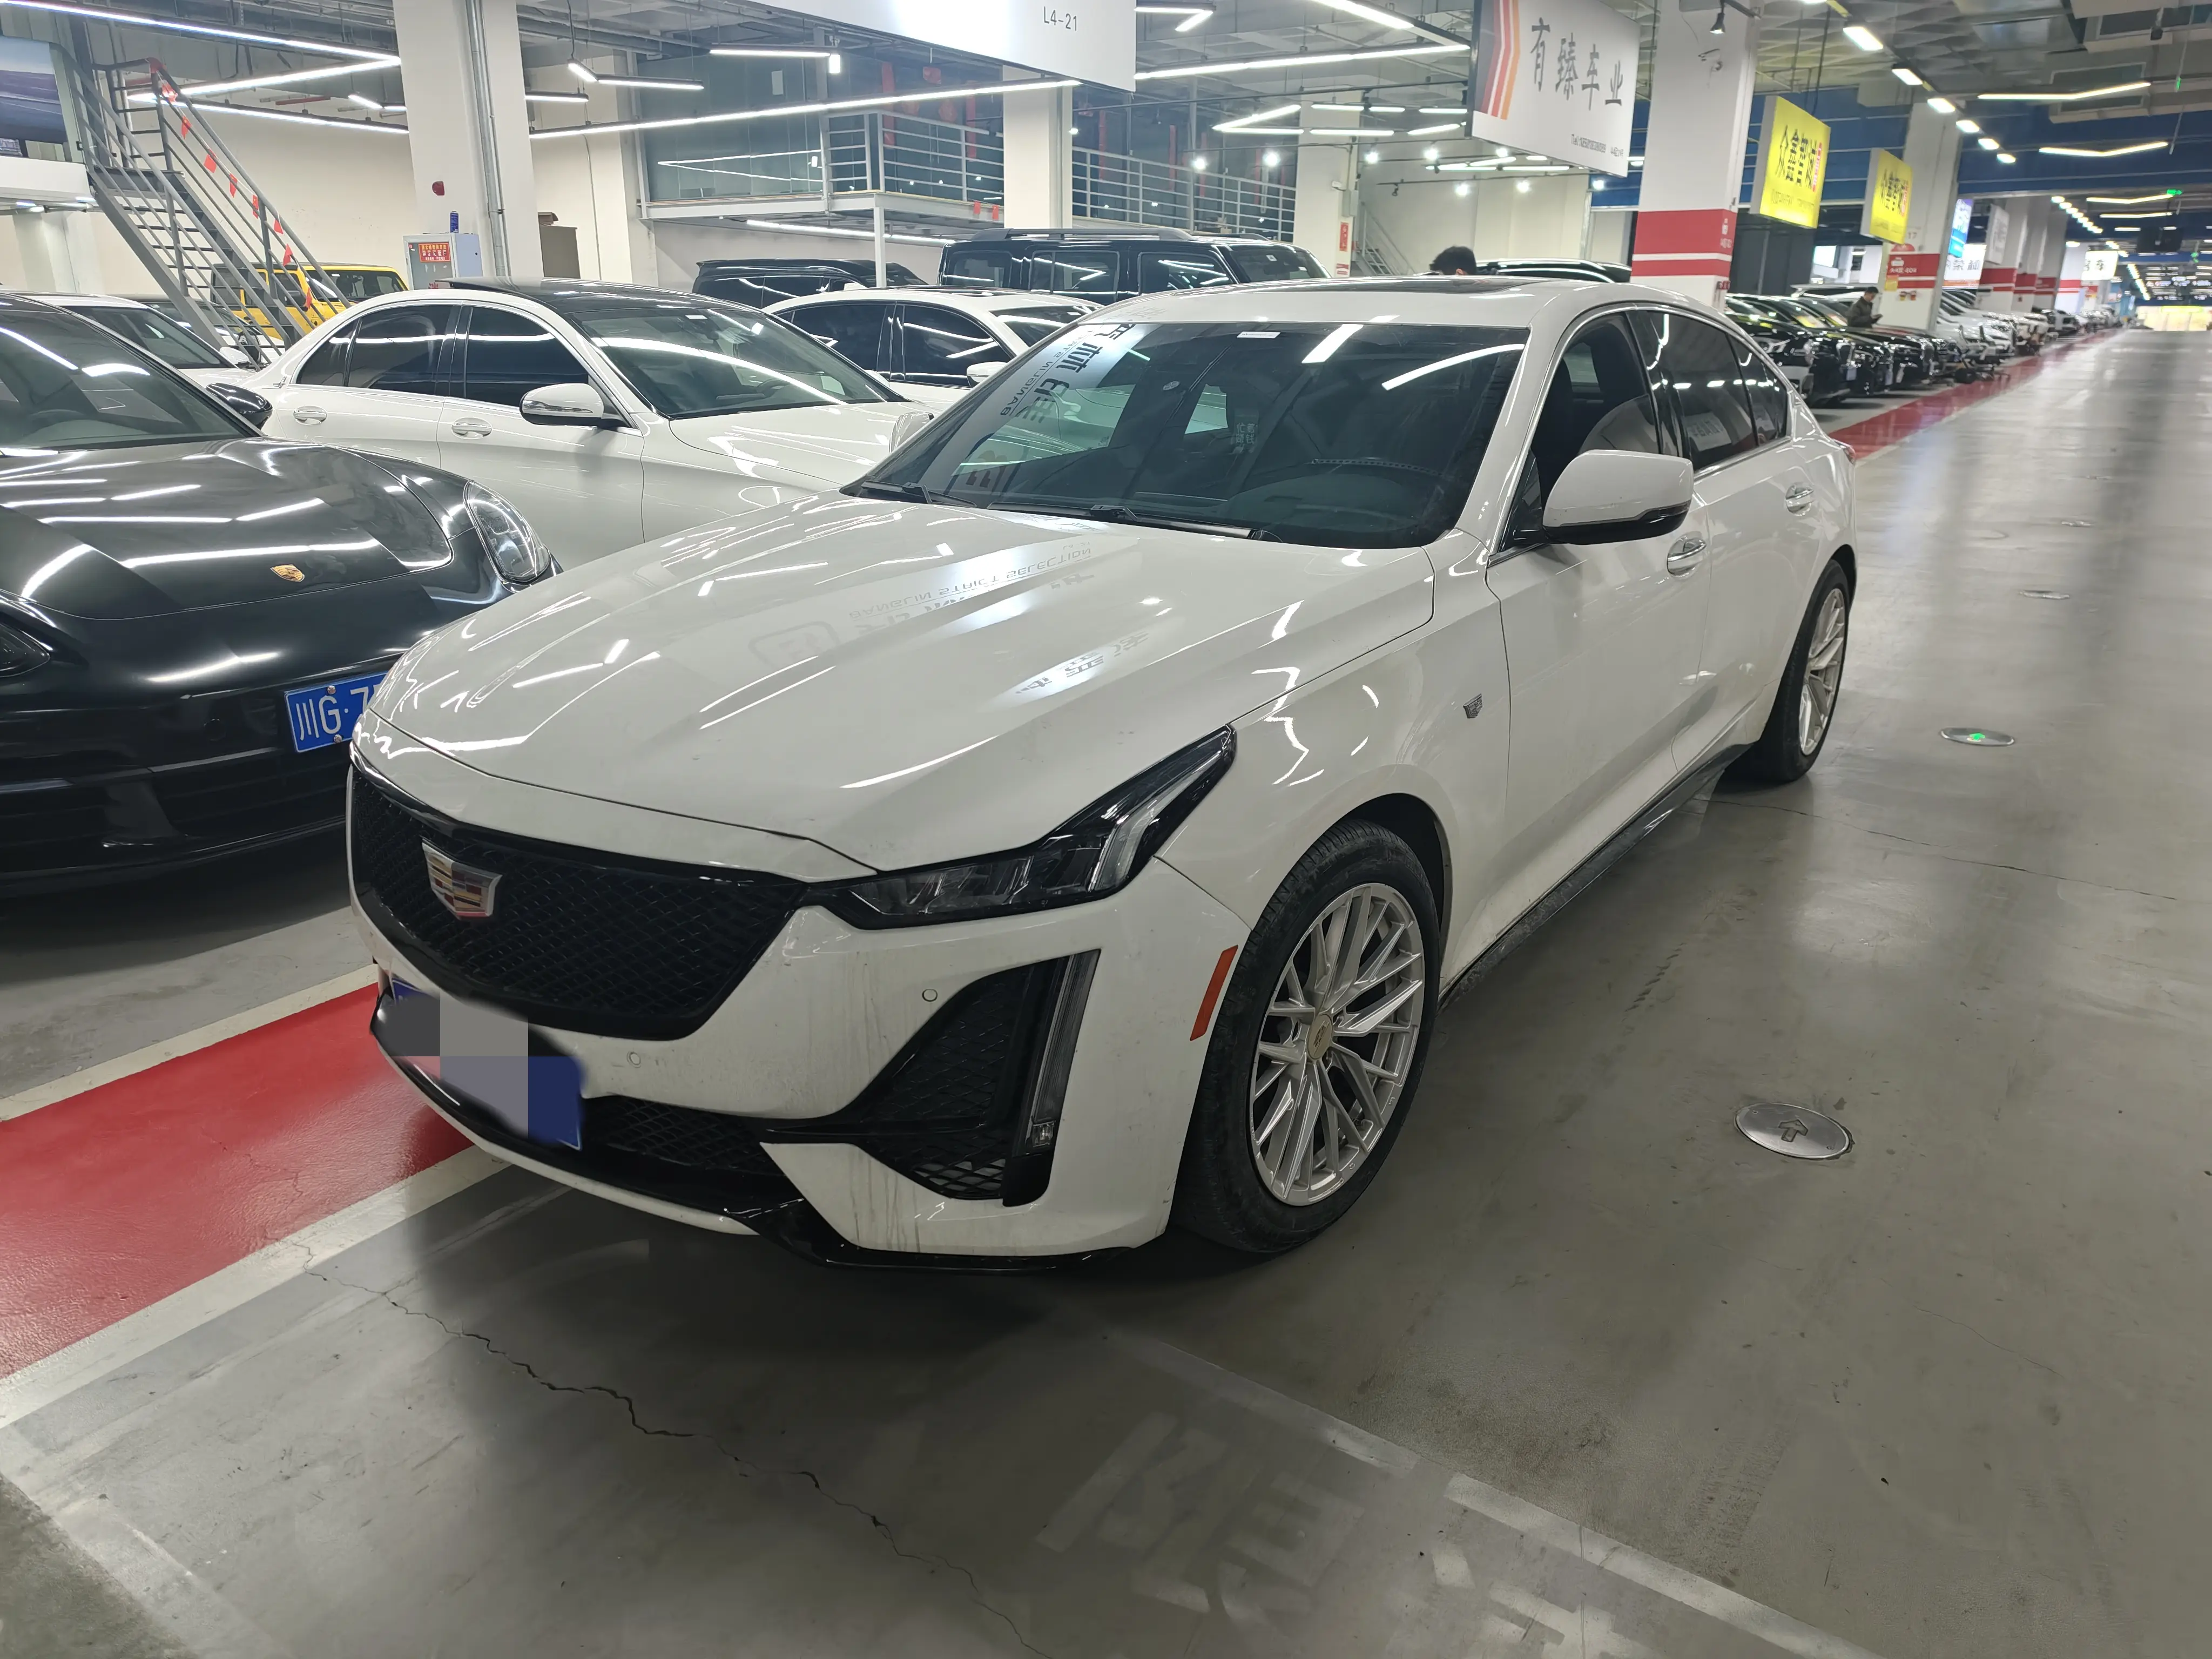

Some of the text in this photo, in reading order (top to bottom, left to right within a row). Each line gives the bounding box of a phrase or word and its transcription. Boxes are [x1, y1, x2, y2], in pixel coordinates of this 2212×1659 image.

[1044, 6, 1077, 31] L4-21
[1530, 17, 1623, 111] 有臻车业
[295, 683, 387, 740] 川G·7
